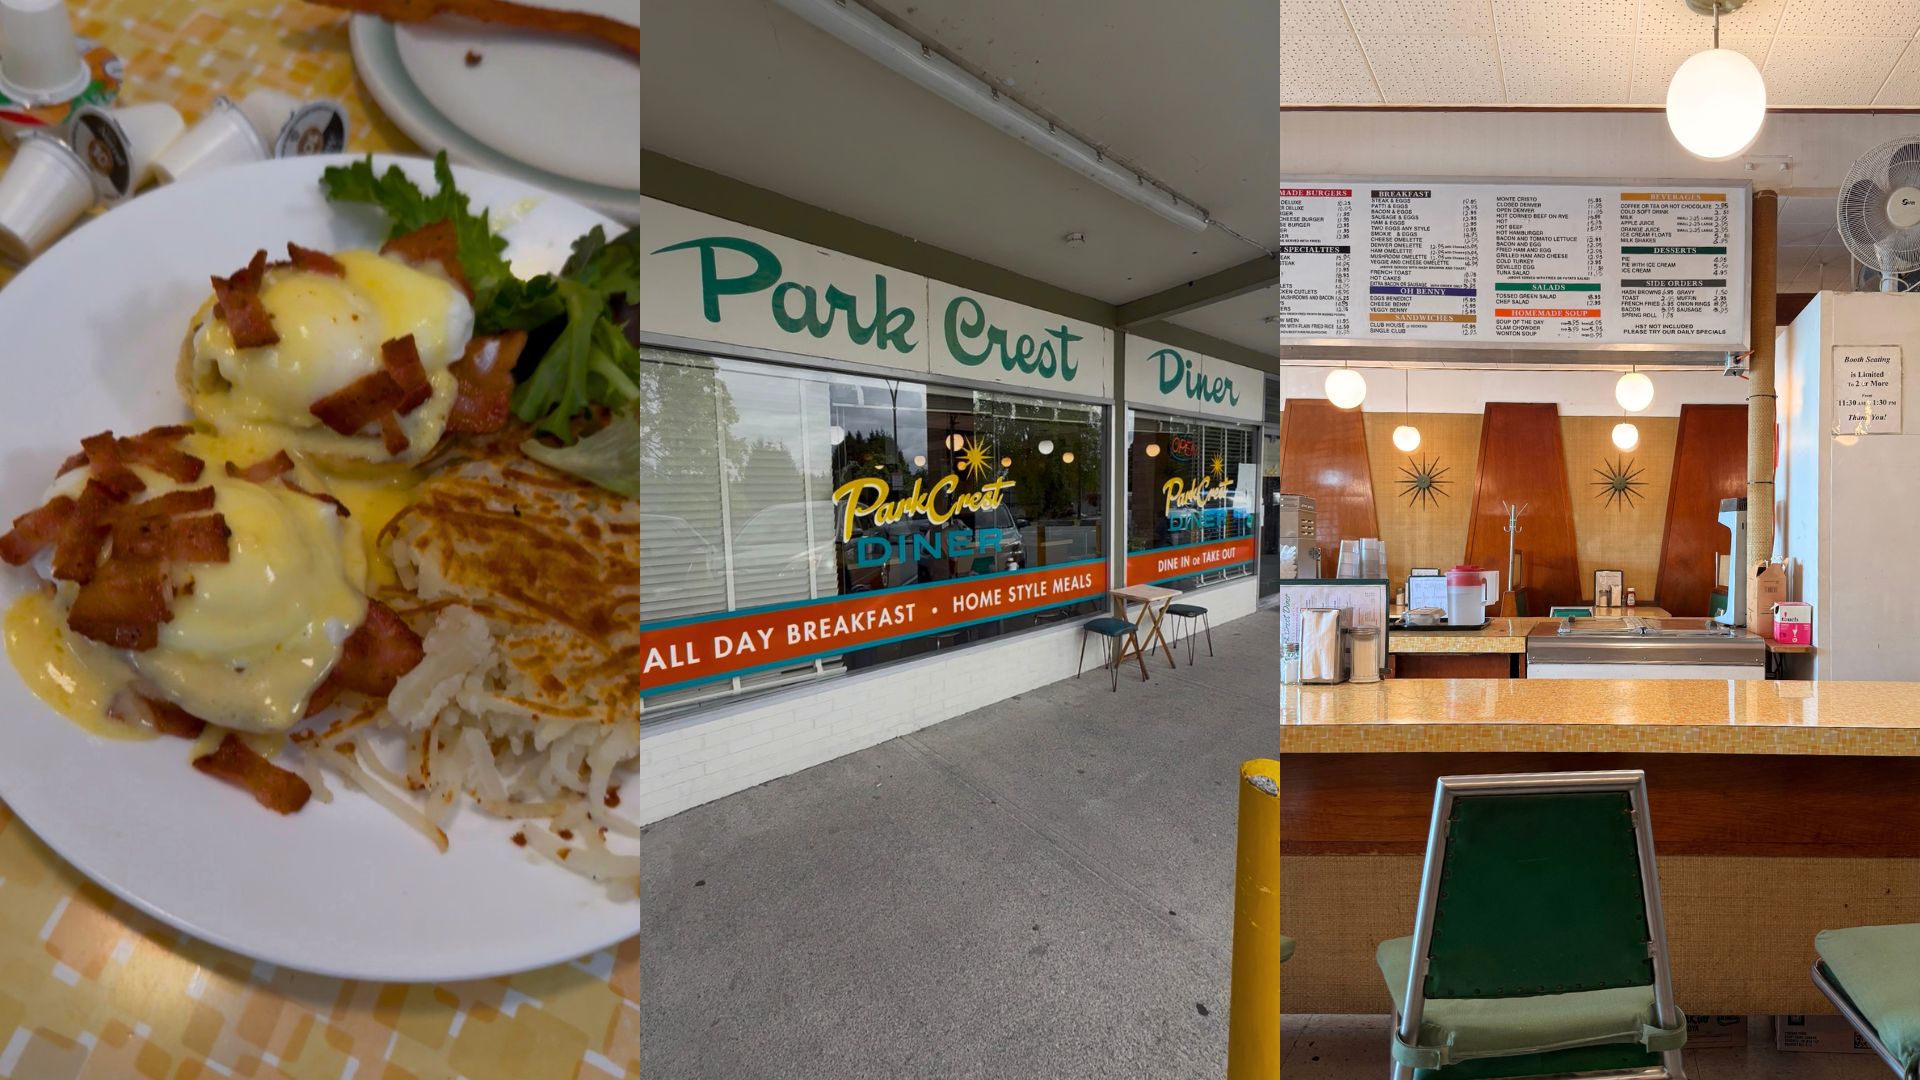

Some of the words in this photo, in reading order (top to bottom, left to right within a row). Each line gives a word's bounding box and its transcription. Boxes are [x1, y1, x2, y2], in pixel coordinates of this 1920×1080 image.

[650, 236, 919, 353] Park
[944, 295, 1084, 381] Crest
[1146, 348, 1240, 407] Diner
[1168, 510, 1228, 532] DINER
[856, 528, 1003, 569] DINER
[1158, 558, 1178, 573] DINE
[1180, 555, 1190, 567] IN
[1202, 550, 1220, 563] TAKE
[1222, 547, 1236, 560] OUT
[642, 641, 701, 674] ALL
[713, 626, 775, 659] DAY
[786, 603, 917, 646] BREAKFAST
[952, 589, 1002, 614] HOME
[1008, 582, 1048, 603] STYLE
[1052, 573, 1092, 595] MEALS
